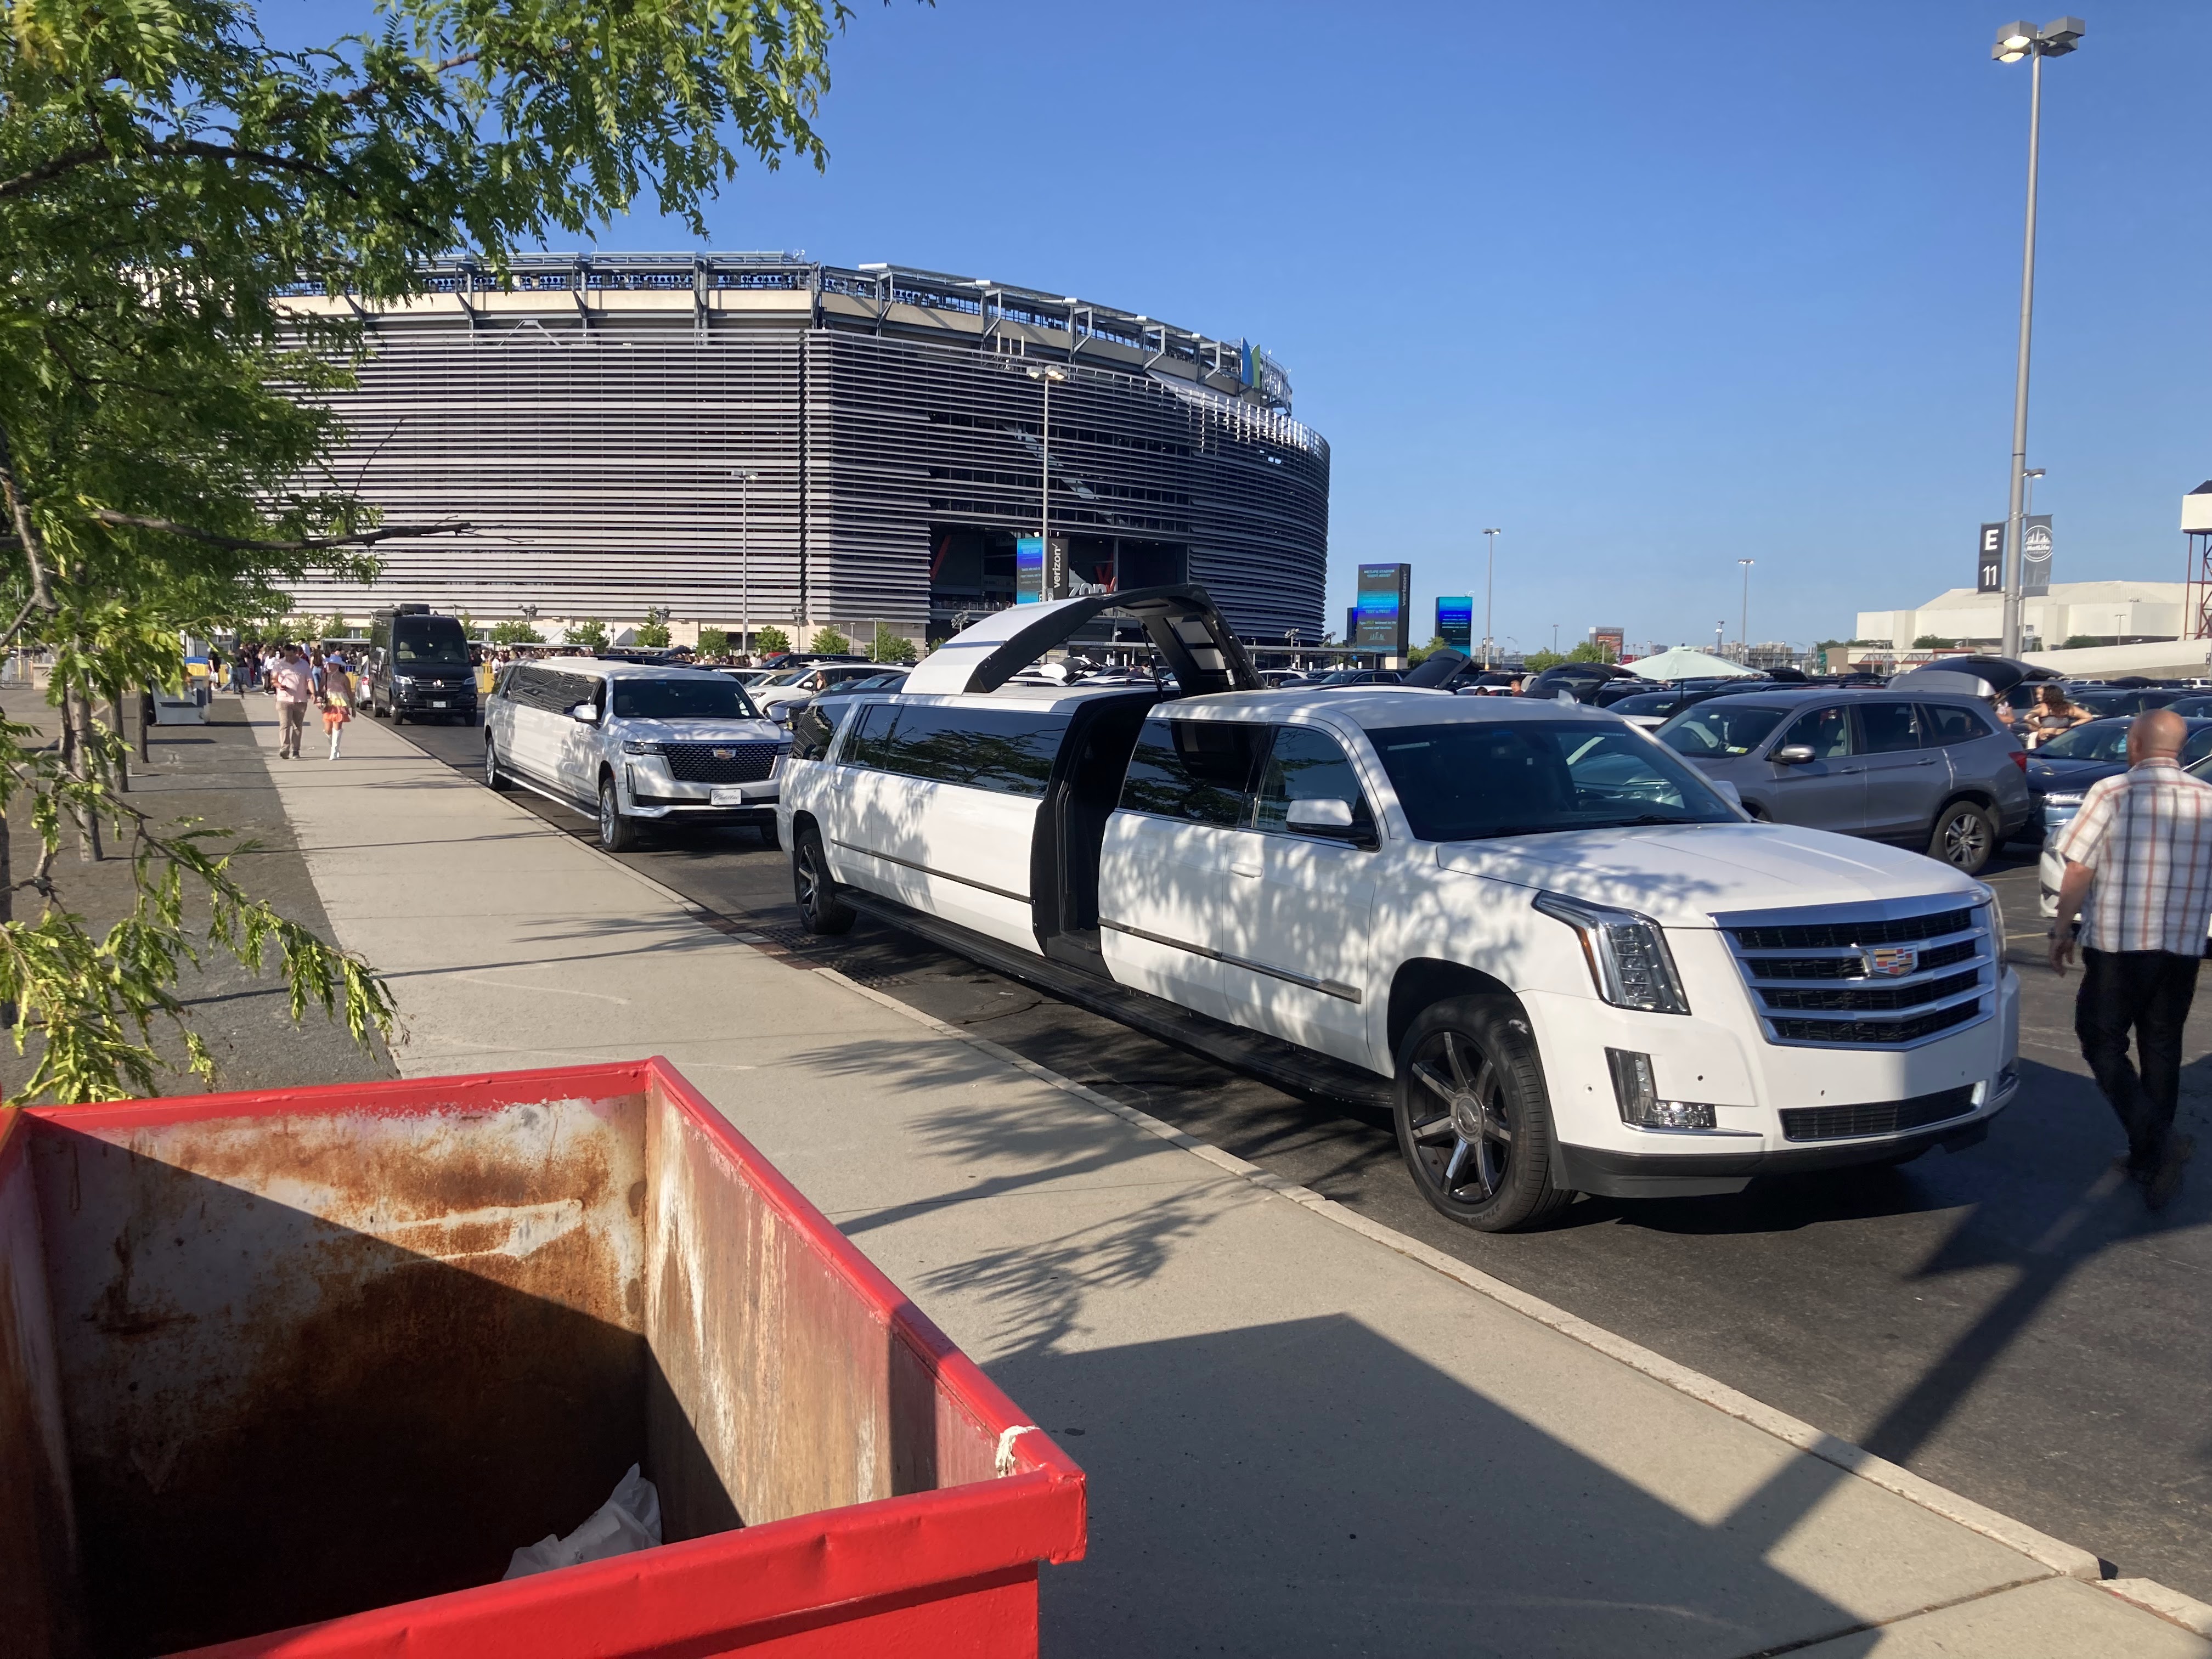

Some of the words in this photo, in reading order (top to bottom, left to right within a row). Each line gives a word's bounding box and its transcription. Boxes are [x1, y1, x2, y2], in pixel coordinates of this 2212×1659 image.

[1984, 529, 1999, 550] E
[1053, 548, 1061, 589] verizon
[1983, 566, 1997, 586] 11
[713, 793, 739, 801] Cadillac
